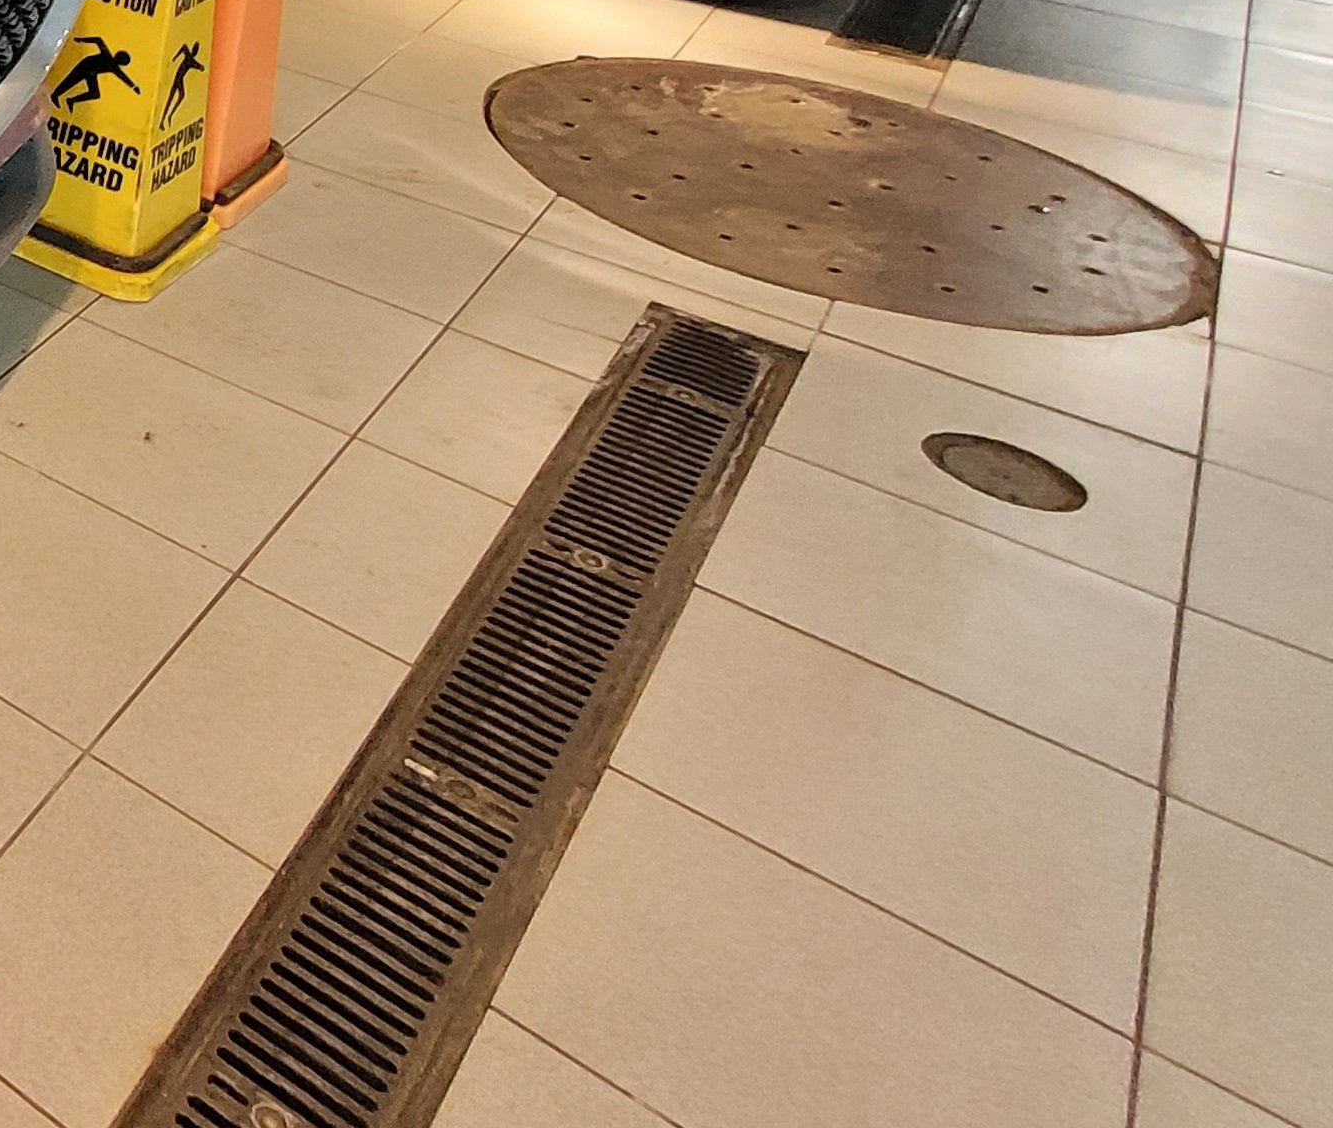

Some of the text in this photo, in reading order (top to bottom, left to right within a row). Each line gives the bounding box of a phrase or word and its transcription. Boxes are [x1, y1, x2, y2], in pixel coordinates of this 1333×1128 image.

[47, 116, 140, 171] RIPPING
[150, 117, 205, 170] TRIPPING
[150, 145, 197, 194] HAZARD
